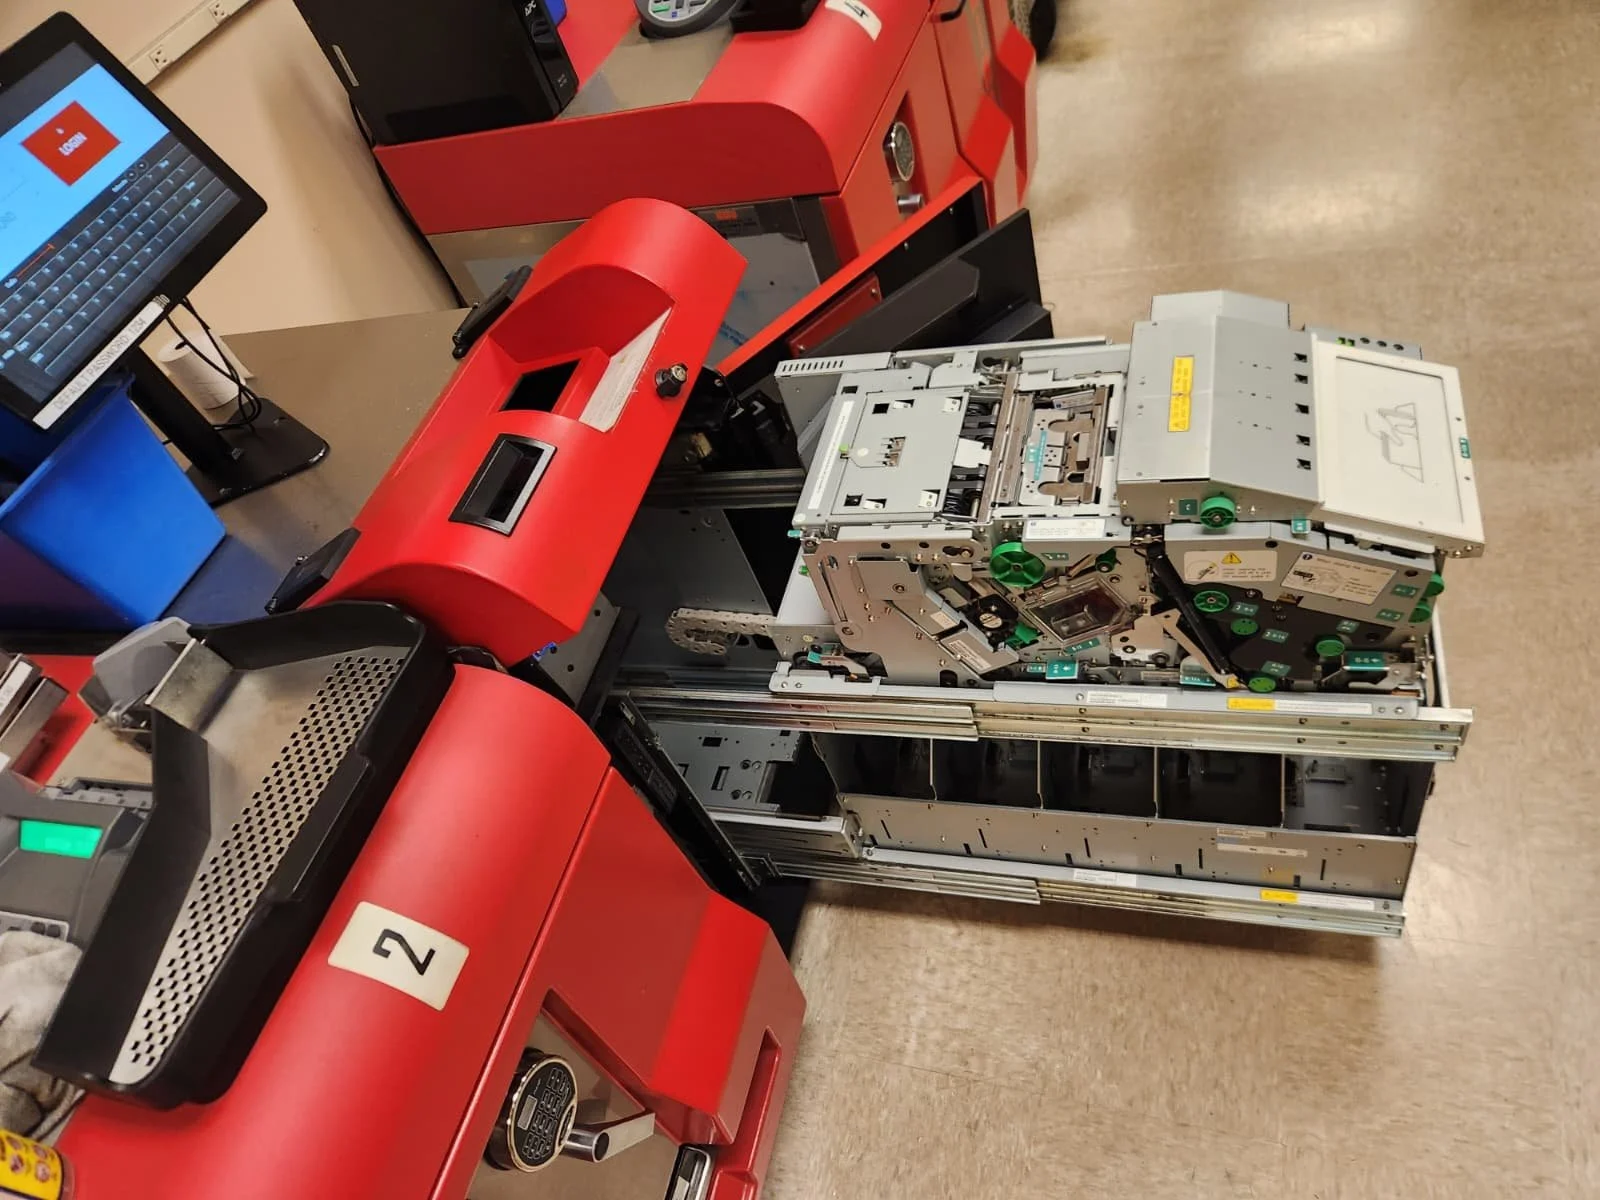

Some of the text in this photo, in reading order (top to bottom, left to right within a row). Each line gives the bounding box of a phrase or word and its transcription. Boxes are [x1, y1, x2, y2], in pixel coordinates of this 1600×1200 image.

[844, 1, 868, 17] 4
[58, 132, 87, 156] LOGIN
[53, 373, 90, 411] DEFAULT
[127, 317, 146, 335] 1234
[373, 929, 436, 975] 2
